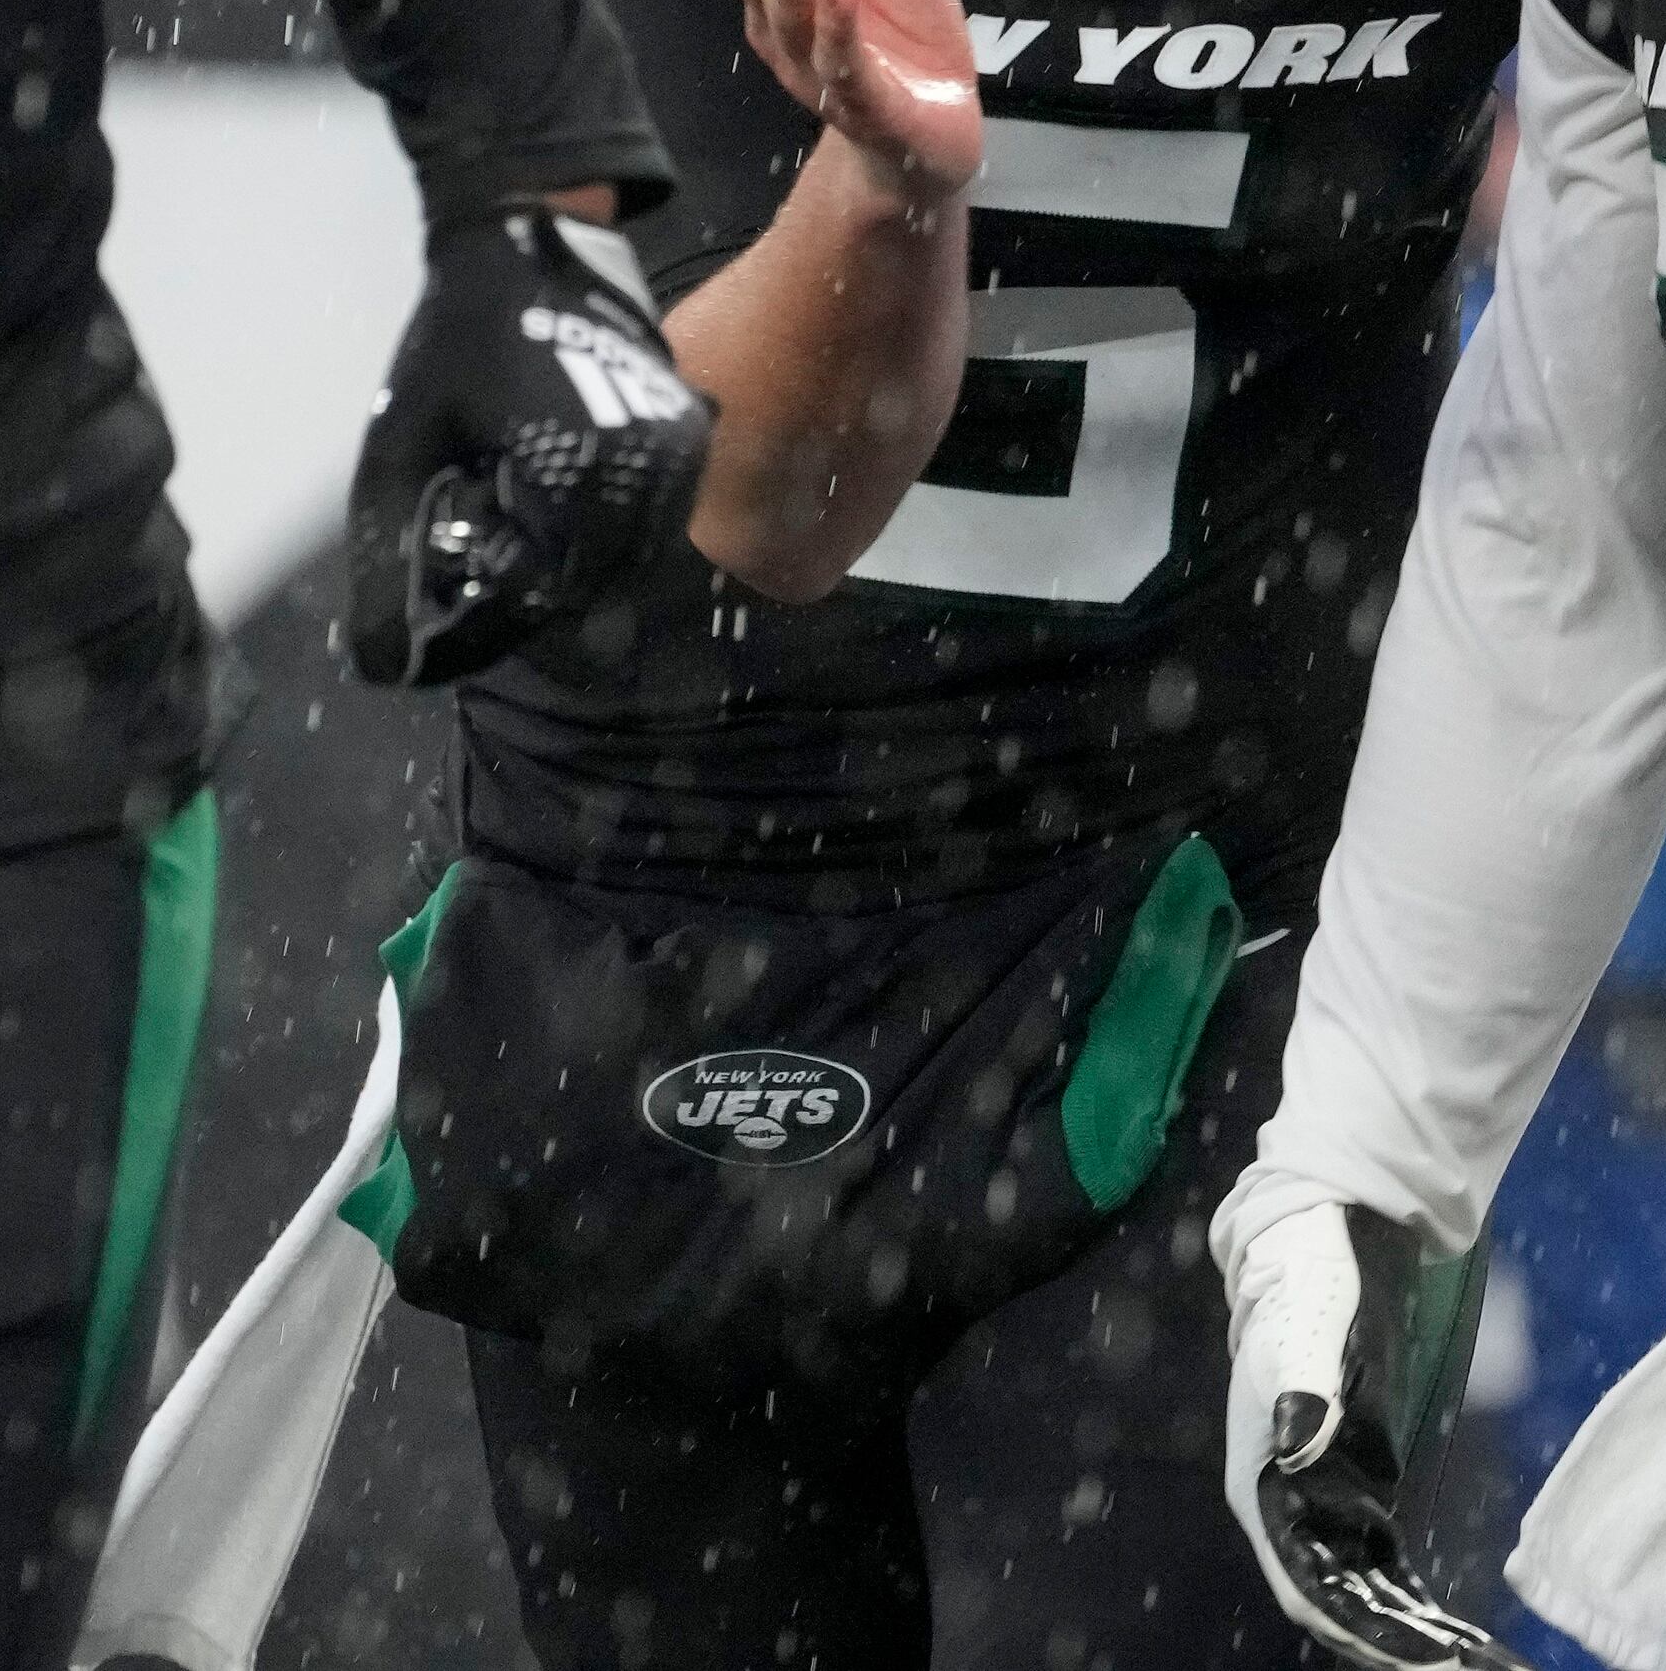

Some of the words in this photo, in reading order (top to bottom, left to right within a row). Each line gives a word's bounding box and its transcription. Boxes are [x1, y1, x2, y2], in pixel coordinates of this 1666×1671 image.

[1074, 12, 1442, 90] YORK
[845, 115, 1250, 605] 5
[694, 1070, 755, 1084] NEW
[757, 1070, 828, 1084] YORK
[676, 1087, 840, 1127] JETS
